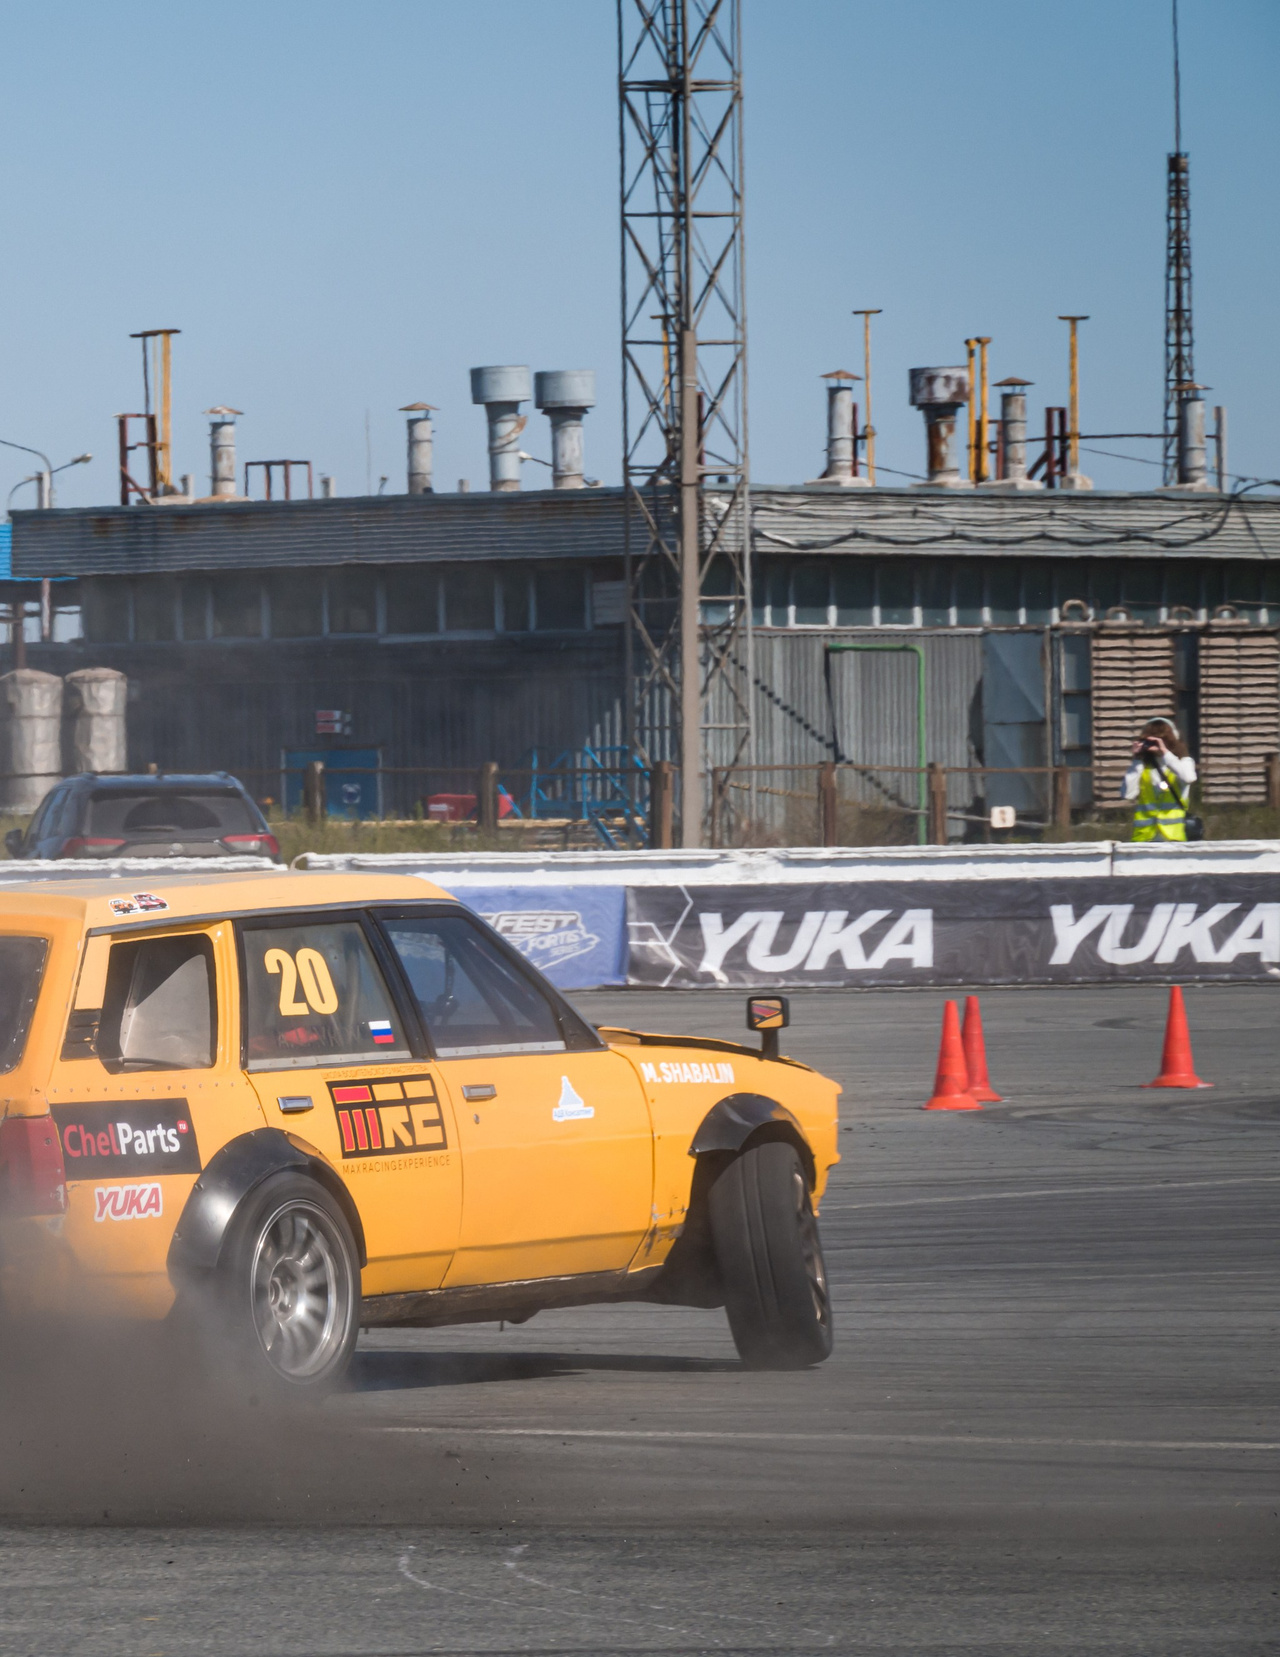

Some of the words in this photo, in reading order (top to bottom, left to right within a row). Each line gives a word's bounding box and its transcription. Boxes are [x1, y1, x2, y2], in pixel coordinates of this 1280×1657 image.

[496, 914, 578, 933] FEST
[698, 908, 933, 972] YUKA
[1049, 902, 1280, 965] YUKA
[264, 948, 338, 1016] 20
[63, 1122, 181, 1158] ChelParts
[97, 1187, 161, 1218] YUKA
